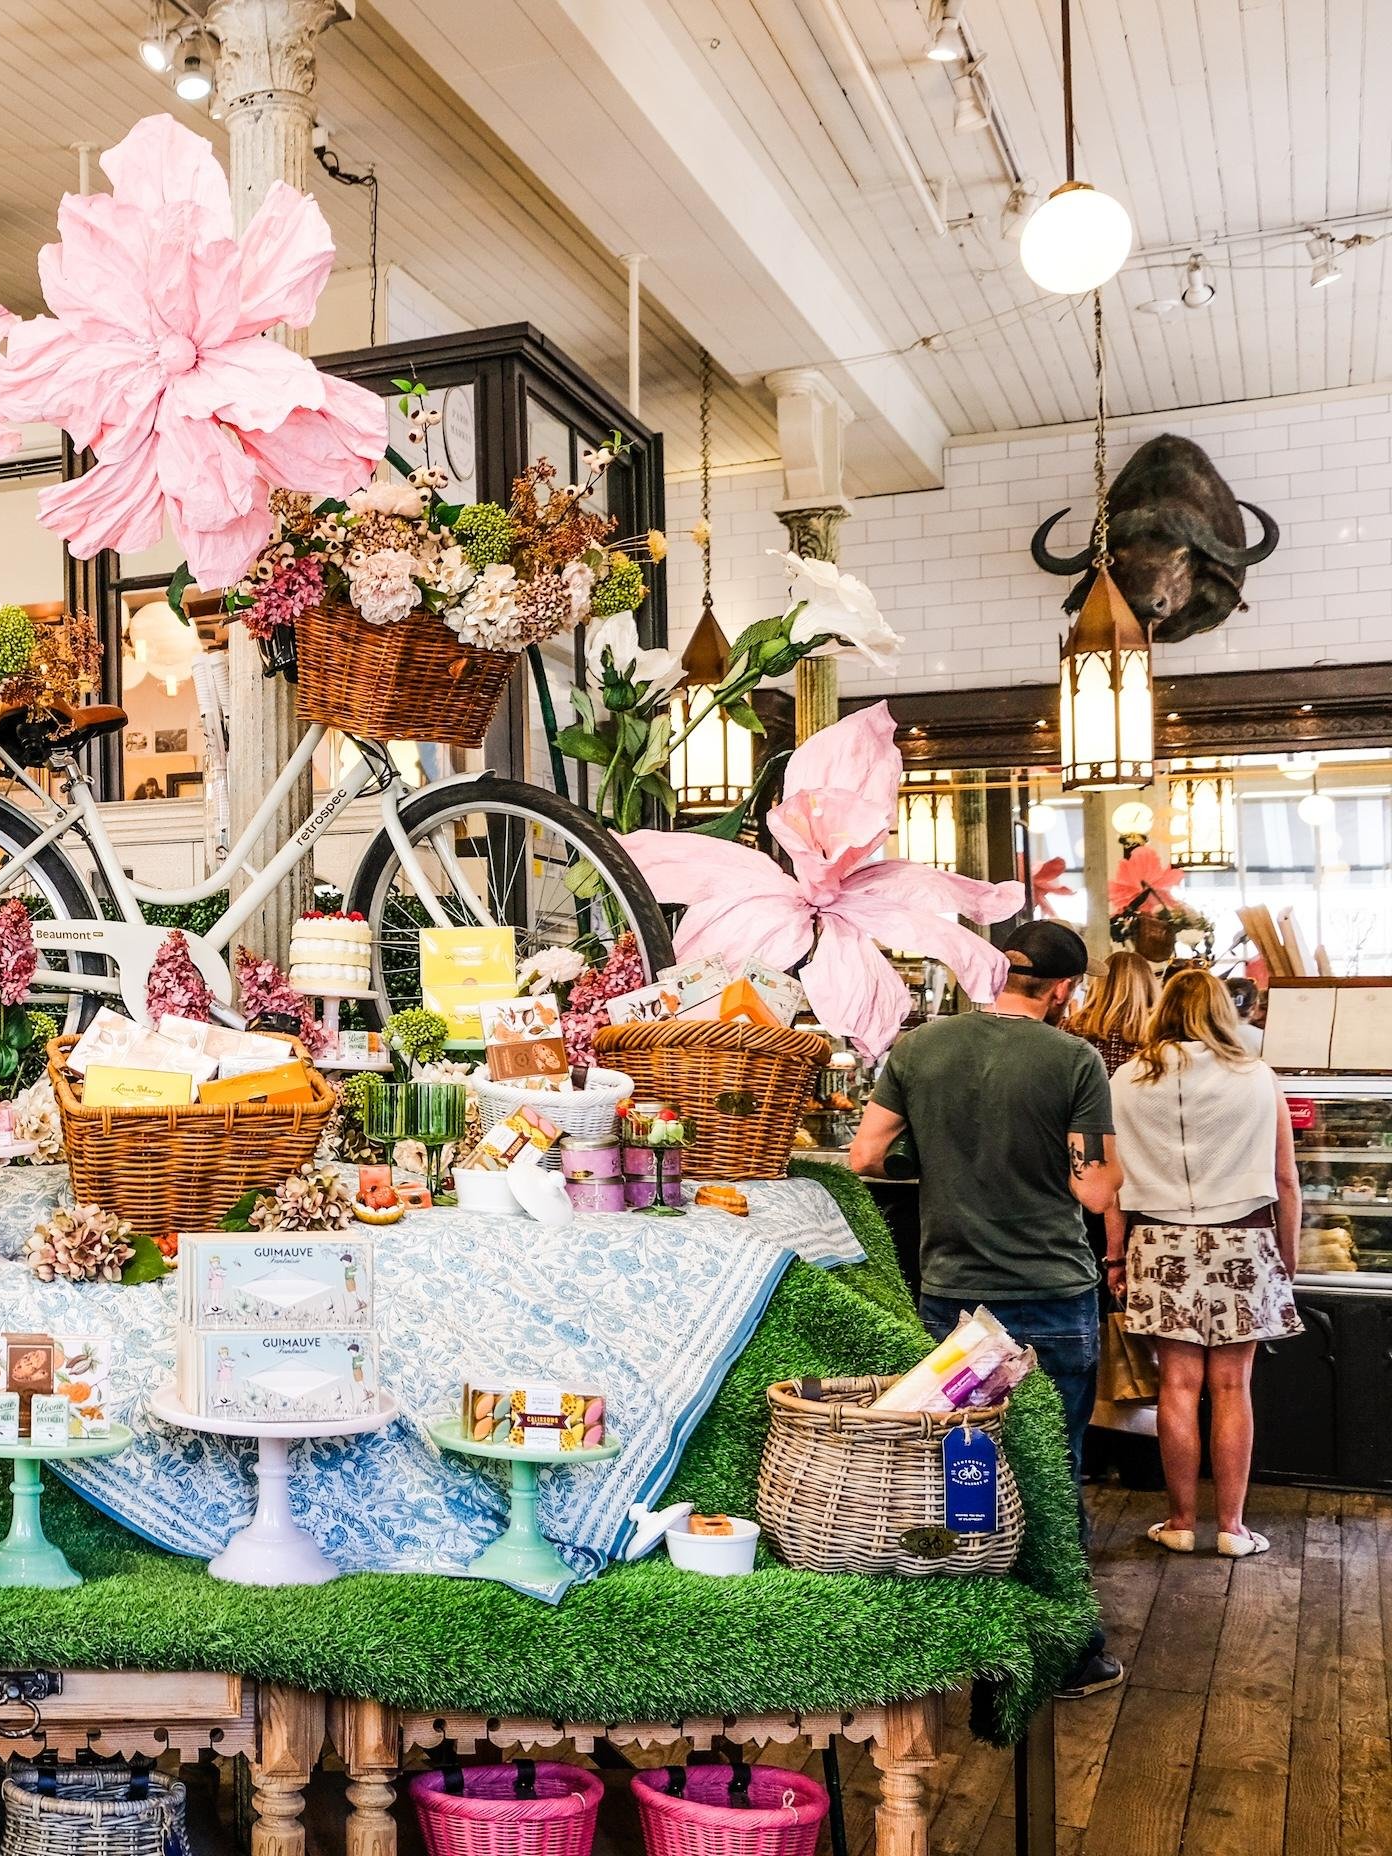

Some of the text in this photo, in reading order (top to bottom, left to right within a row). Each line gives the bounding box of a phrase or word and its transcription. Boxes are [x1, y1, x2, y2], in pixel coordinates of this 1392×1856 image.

[296, 789, 347, 846] retrospec
[36, 930, 91, 940] Beaumont
[254, 1247, 313, 1257] GUIMAUVE
[262, 1337, 321, 1347] GUIMAUVE
[526, 1416, 559, 1424] CALISSONS
